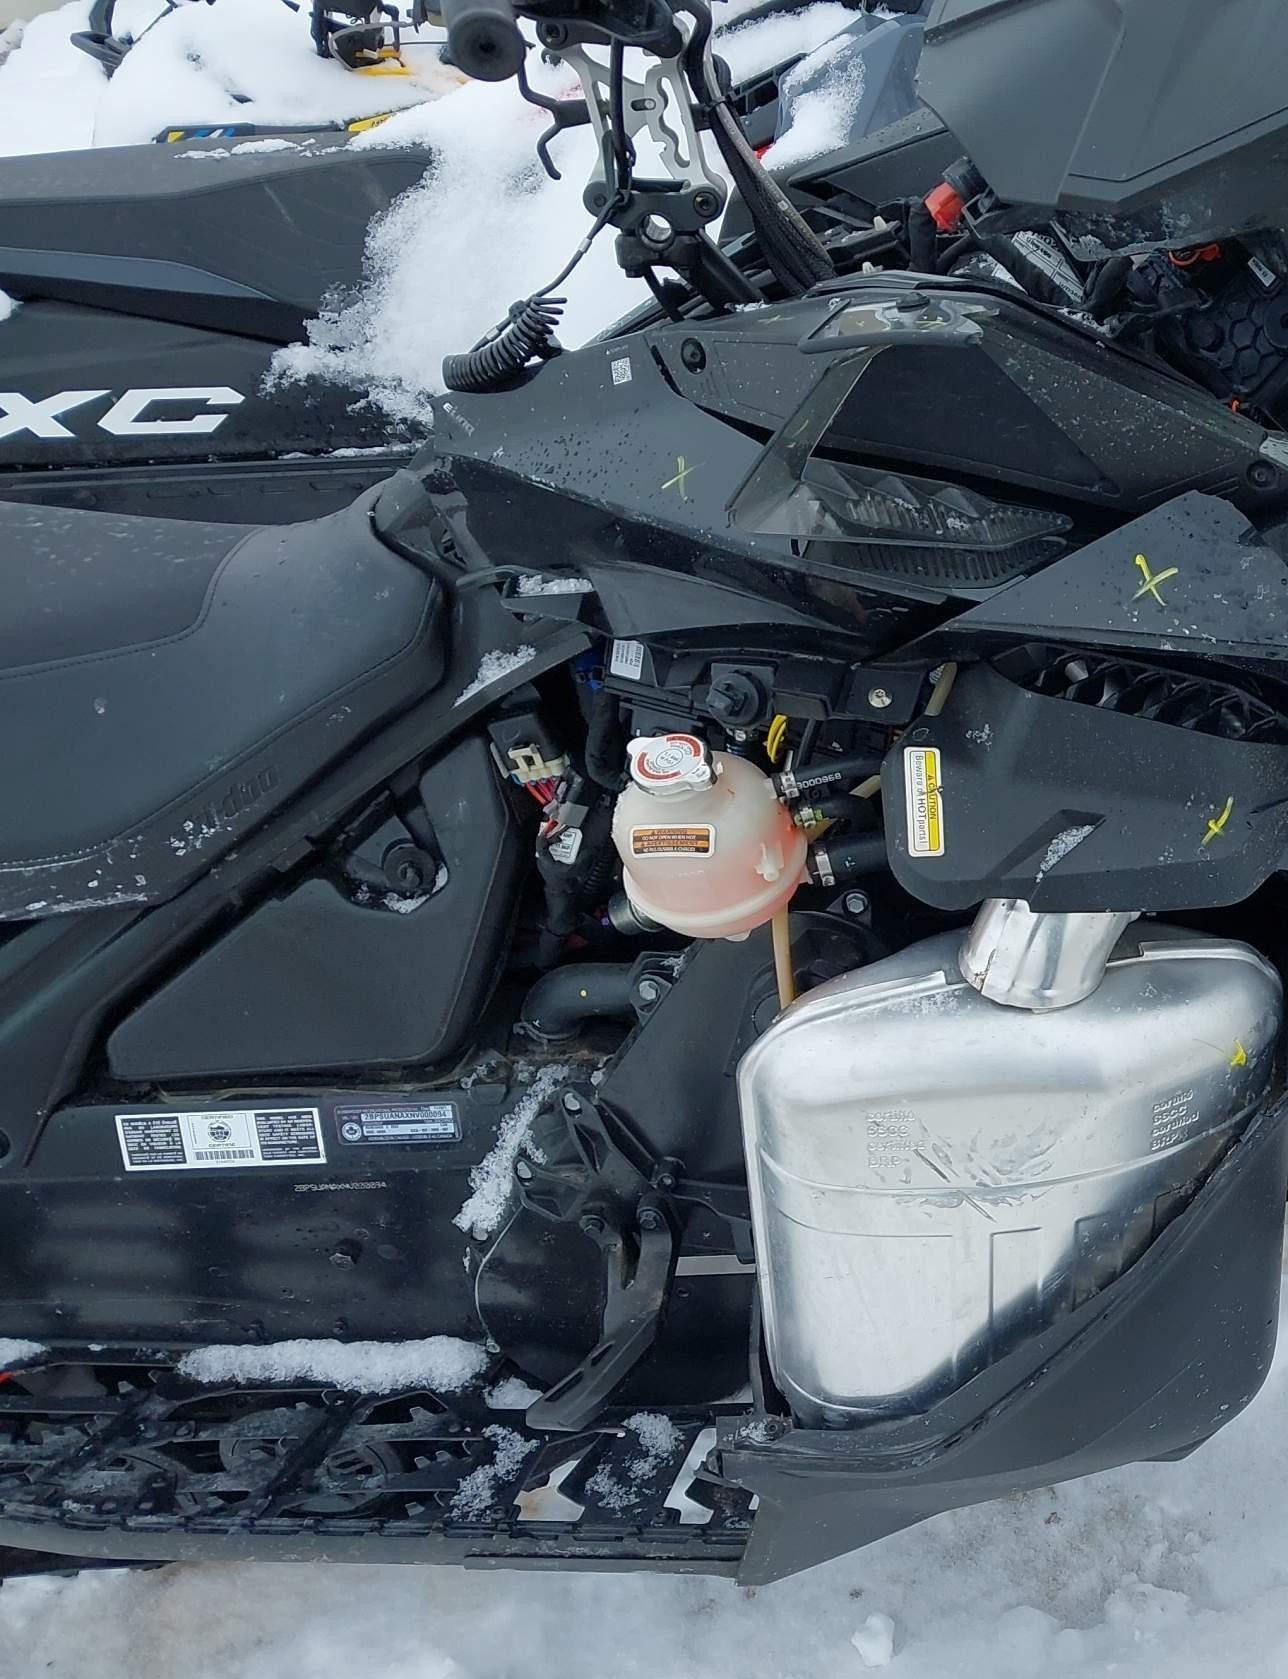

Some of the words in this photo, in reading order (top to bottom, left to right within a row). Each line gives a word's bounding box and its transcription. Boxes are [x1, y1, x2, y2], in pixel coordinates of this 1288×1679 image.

[0, 386, 247, 438] XC
[918, 799, 927, 819] HOT
[868, 1156, 902, 1168] BRP
